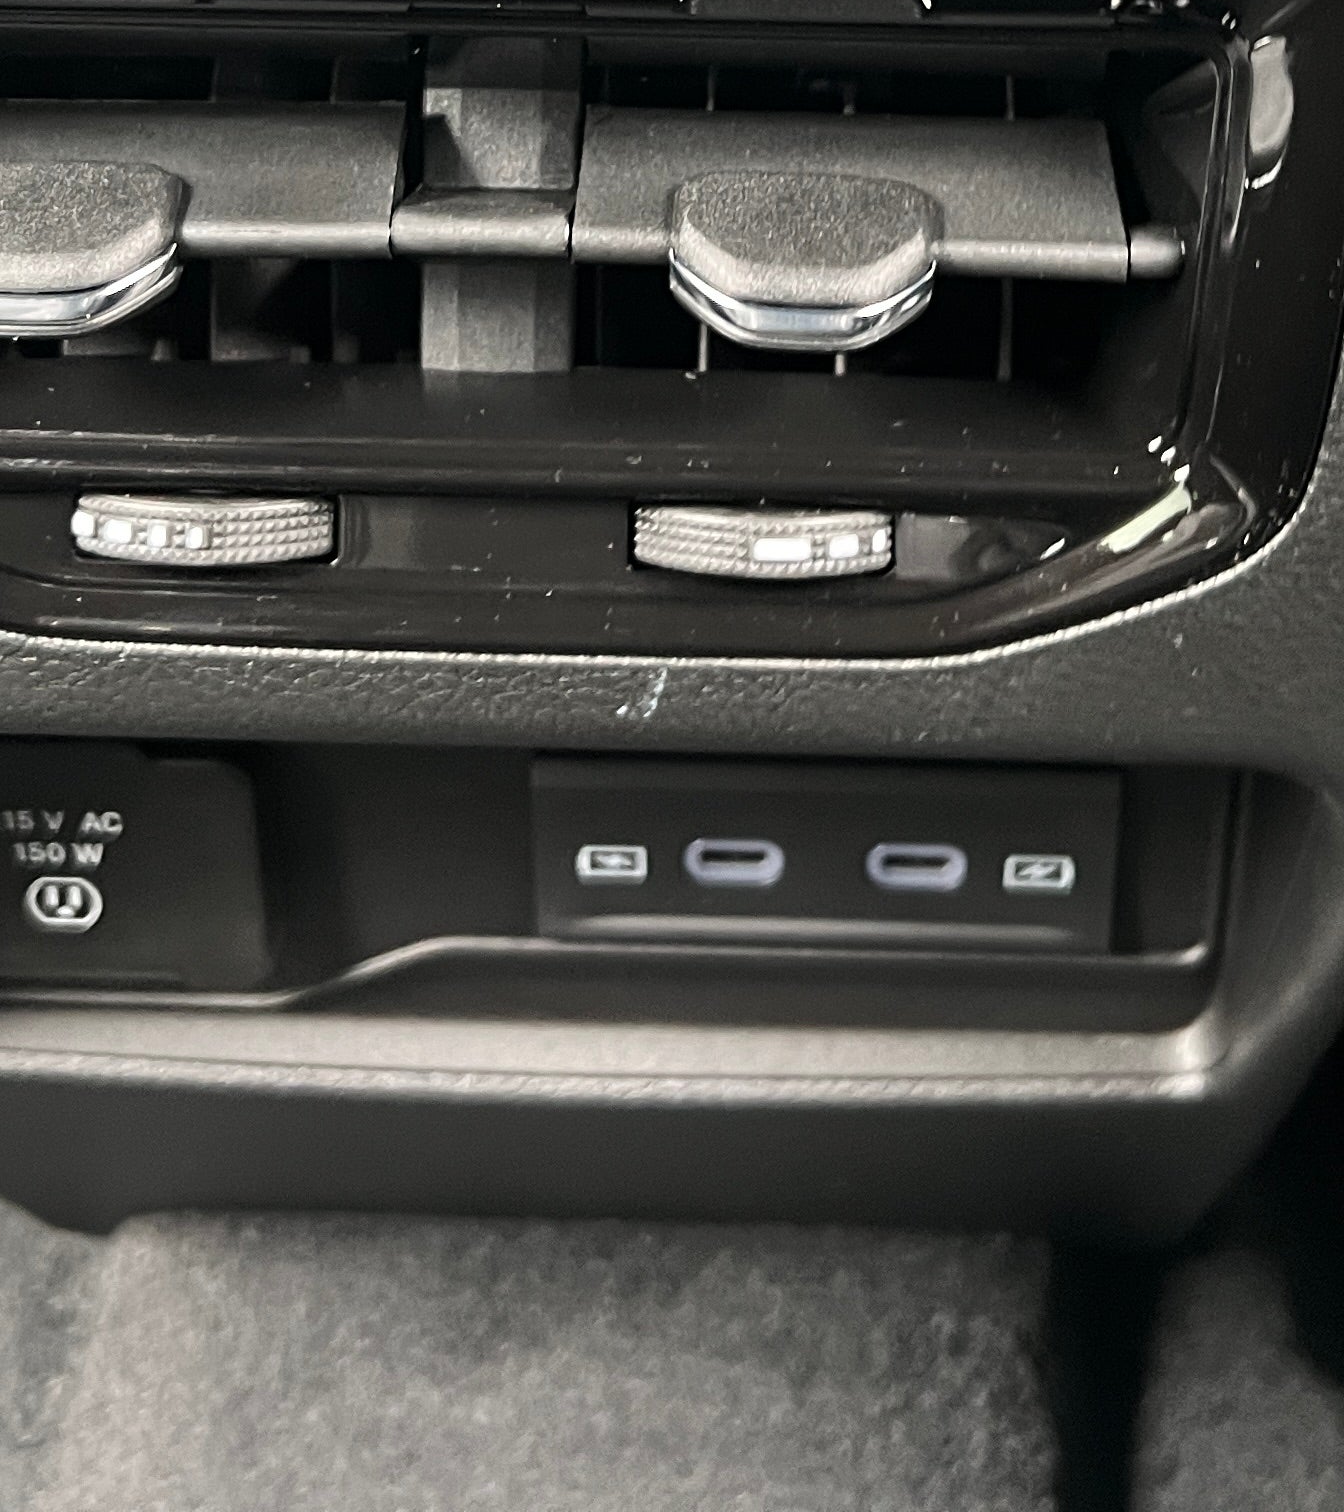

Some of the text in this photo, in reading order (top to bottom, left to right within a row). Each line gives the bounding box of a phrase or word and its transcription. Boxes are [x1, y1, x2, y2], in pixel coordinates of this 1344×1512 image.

[42, 809, 65, 832] V
[79, 810, 124, 836] AC
[13, 841, 104, 866] 150 W
